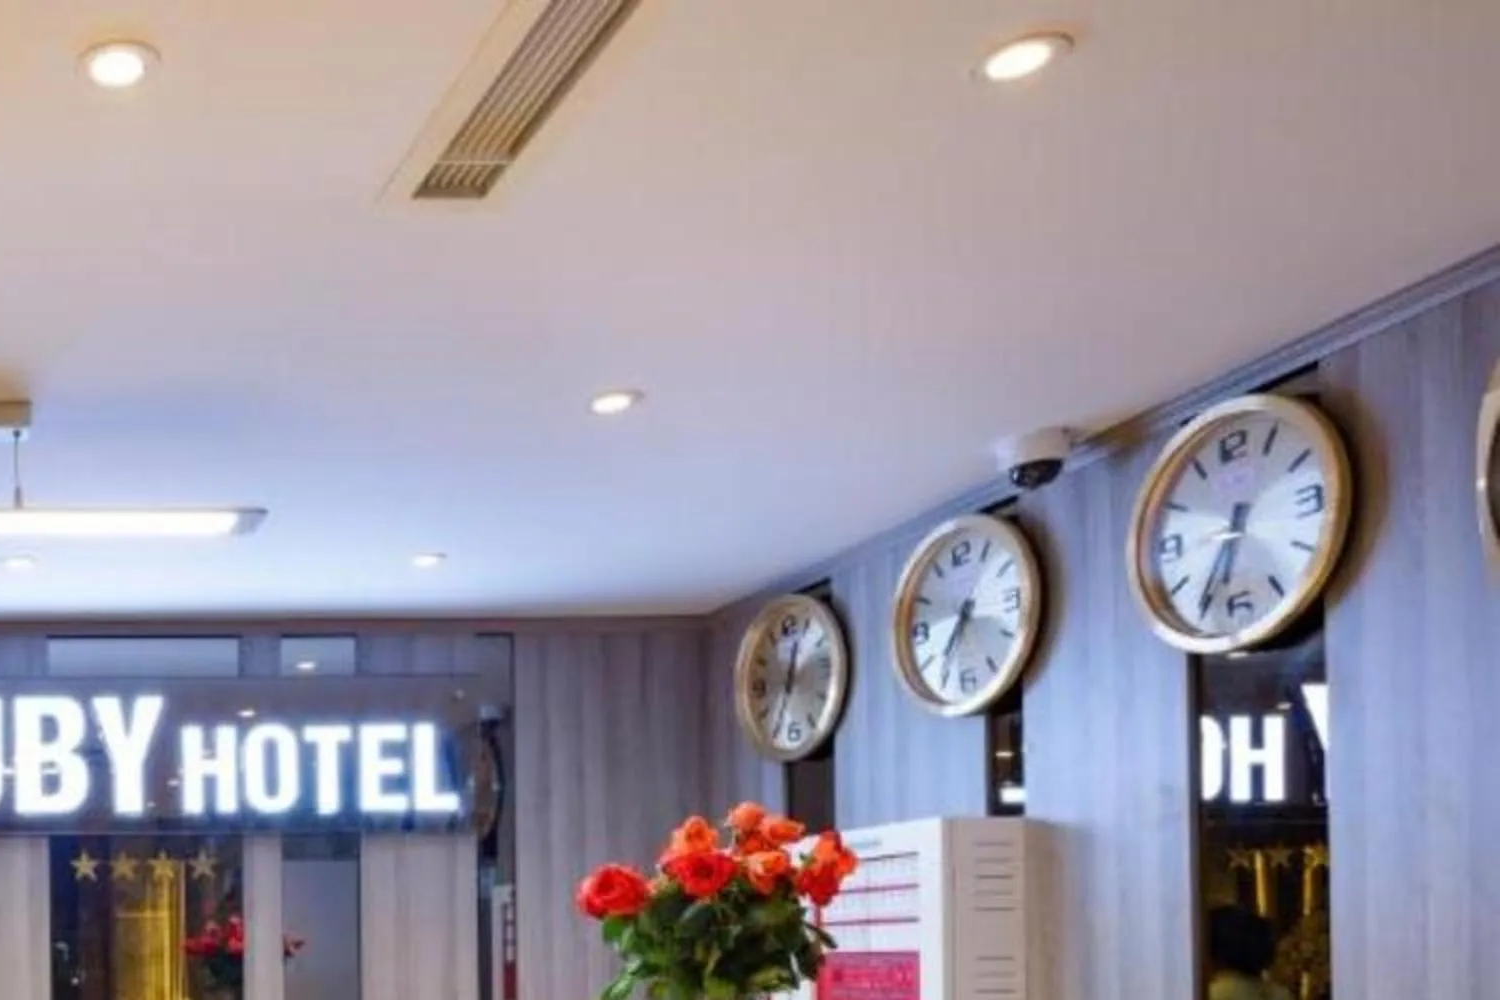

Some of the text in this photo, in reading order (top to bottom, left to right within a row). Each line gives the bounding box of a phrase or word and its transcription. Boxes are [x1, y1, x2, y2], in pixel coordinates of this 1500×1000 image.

[1218, 429, 1248, 464] 12
[1160, 484, 1324, 562] 9 3
[1003, 588, 1020, 613] 3
[960, 668, 978, 693] 6
[787, 721, 802, 743] 6
[181, 722, 461, 815] HOTEL
